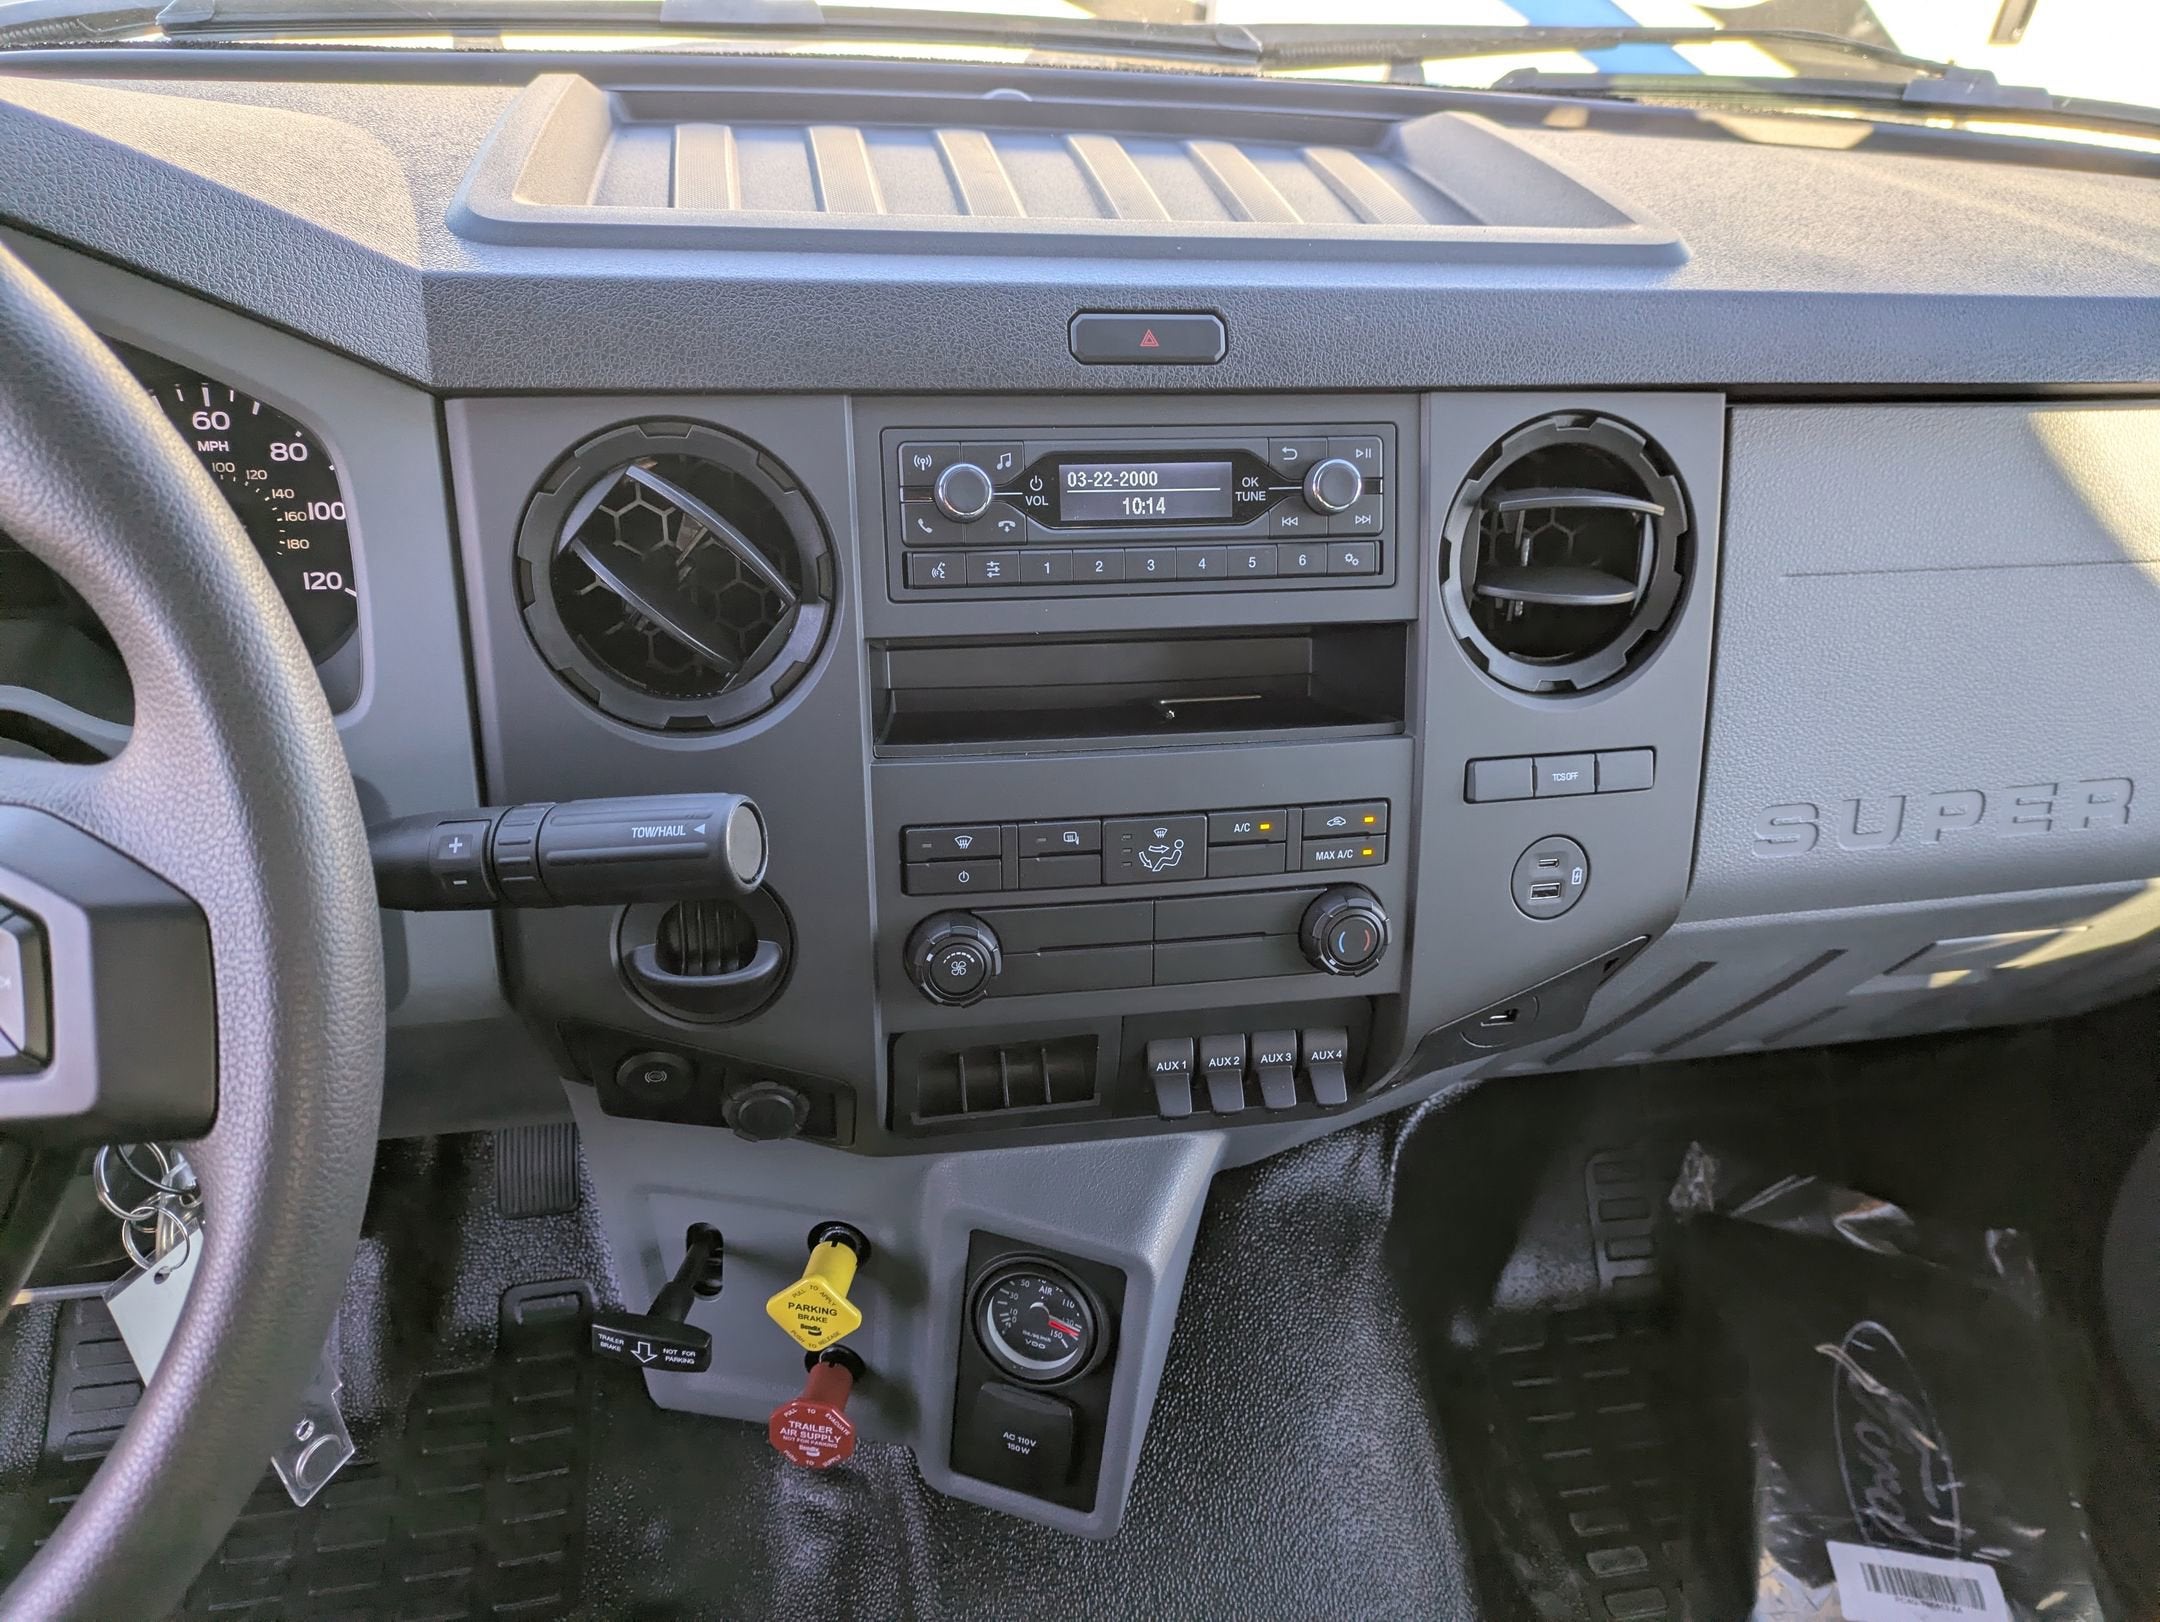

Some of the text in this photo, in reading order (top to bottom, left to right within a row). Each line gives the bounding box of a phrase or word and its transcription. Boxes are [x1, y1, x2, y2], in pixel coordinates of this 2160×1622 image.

[192, 411, 231, 431] 60
[197, 440, 230, 452] MPH
[269, 442, 308, 462] 80
[211, 461, 235, 474] 100
[246, 469, 268, 481] 120
[1067, 470, 1159, 488] 03-22-2000
[1241, 476, 1260, 488] OK
[271, 488, 295, 499] 140
[1235, 490, 1267, 502] TUNE
[1025, 495, 1049, 507] VOL
[1122, 496, 1167, 516] 10:14
[284, 511, 307, 522] 160
[307, 501, 345, 521] 100
[286, 538, 310, 550] 180
[1095, 560, 1104, 573] 2
[1147, 558, 1156, 572] 3
[1198, 557, 1207, 571] 4
[1248, 555, 1257, 569] 5
[1298, 554, 1307, 567] 6
[1043, 561, 1051, 575] 1
[303, 571, 343, 591] 120
[1552, 772, 1566, 782] TCS
[1752, 776, 2135, 859] SUPER
[631, 824, 686, 839] TOW/HAUL
[1233, 822, 1251, 833] A/C
[1315, 849, 1354, 861] MAX A/C
[1260, 1052, 1292, 1064] AUX 3
[1311, 1050, 1342, 1061] AUX 4
[1156, 1060, 1187, 1073] AUX 1
[1208, 1056, 1240, 1068] AUX 2
[1020, 1278, 1030, 1287] 50
[1038, 1285, 1052, 1296] AIR
[788, 1302, 838, 1316] PARKING
[797, 1313, 828, 1323] BRAKE
[598, 1333, 625, 1346] TRAILER
[1050, 1329, 1063, 1339] 150
[600, 1341, 622, 1352] BRAKE
[665, 1355, 695, 1365] PARKING
[788, 1420, 833, 1434] TRAILER
[779, 1427, 842, 1444] AIR SUPPLY
